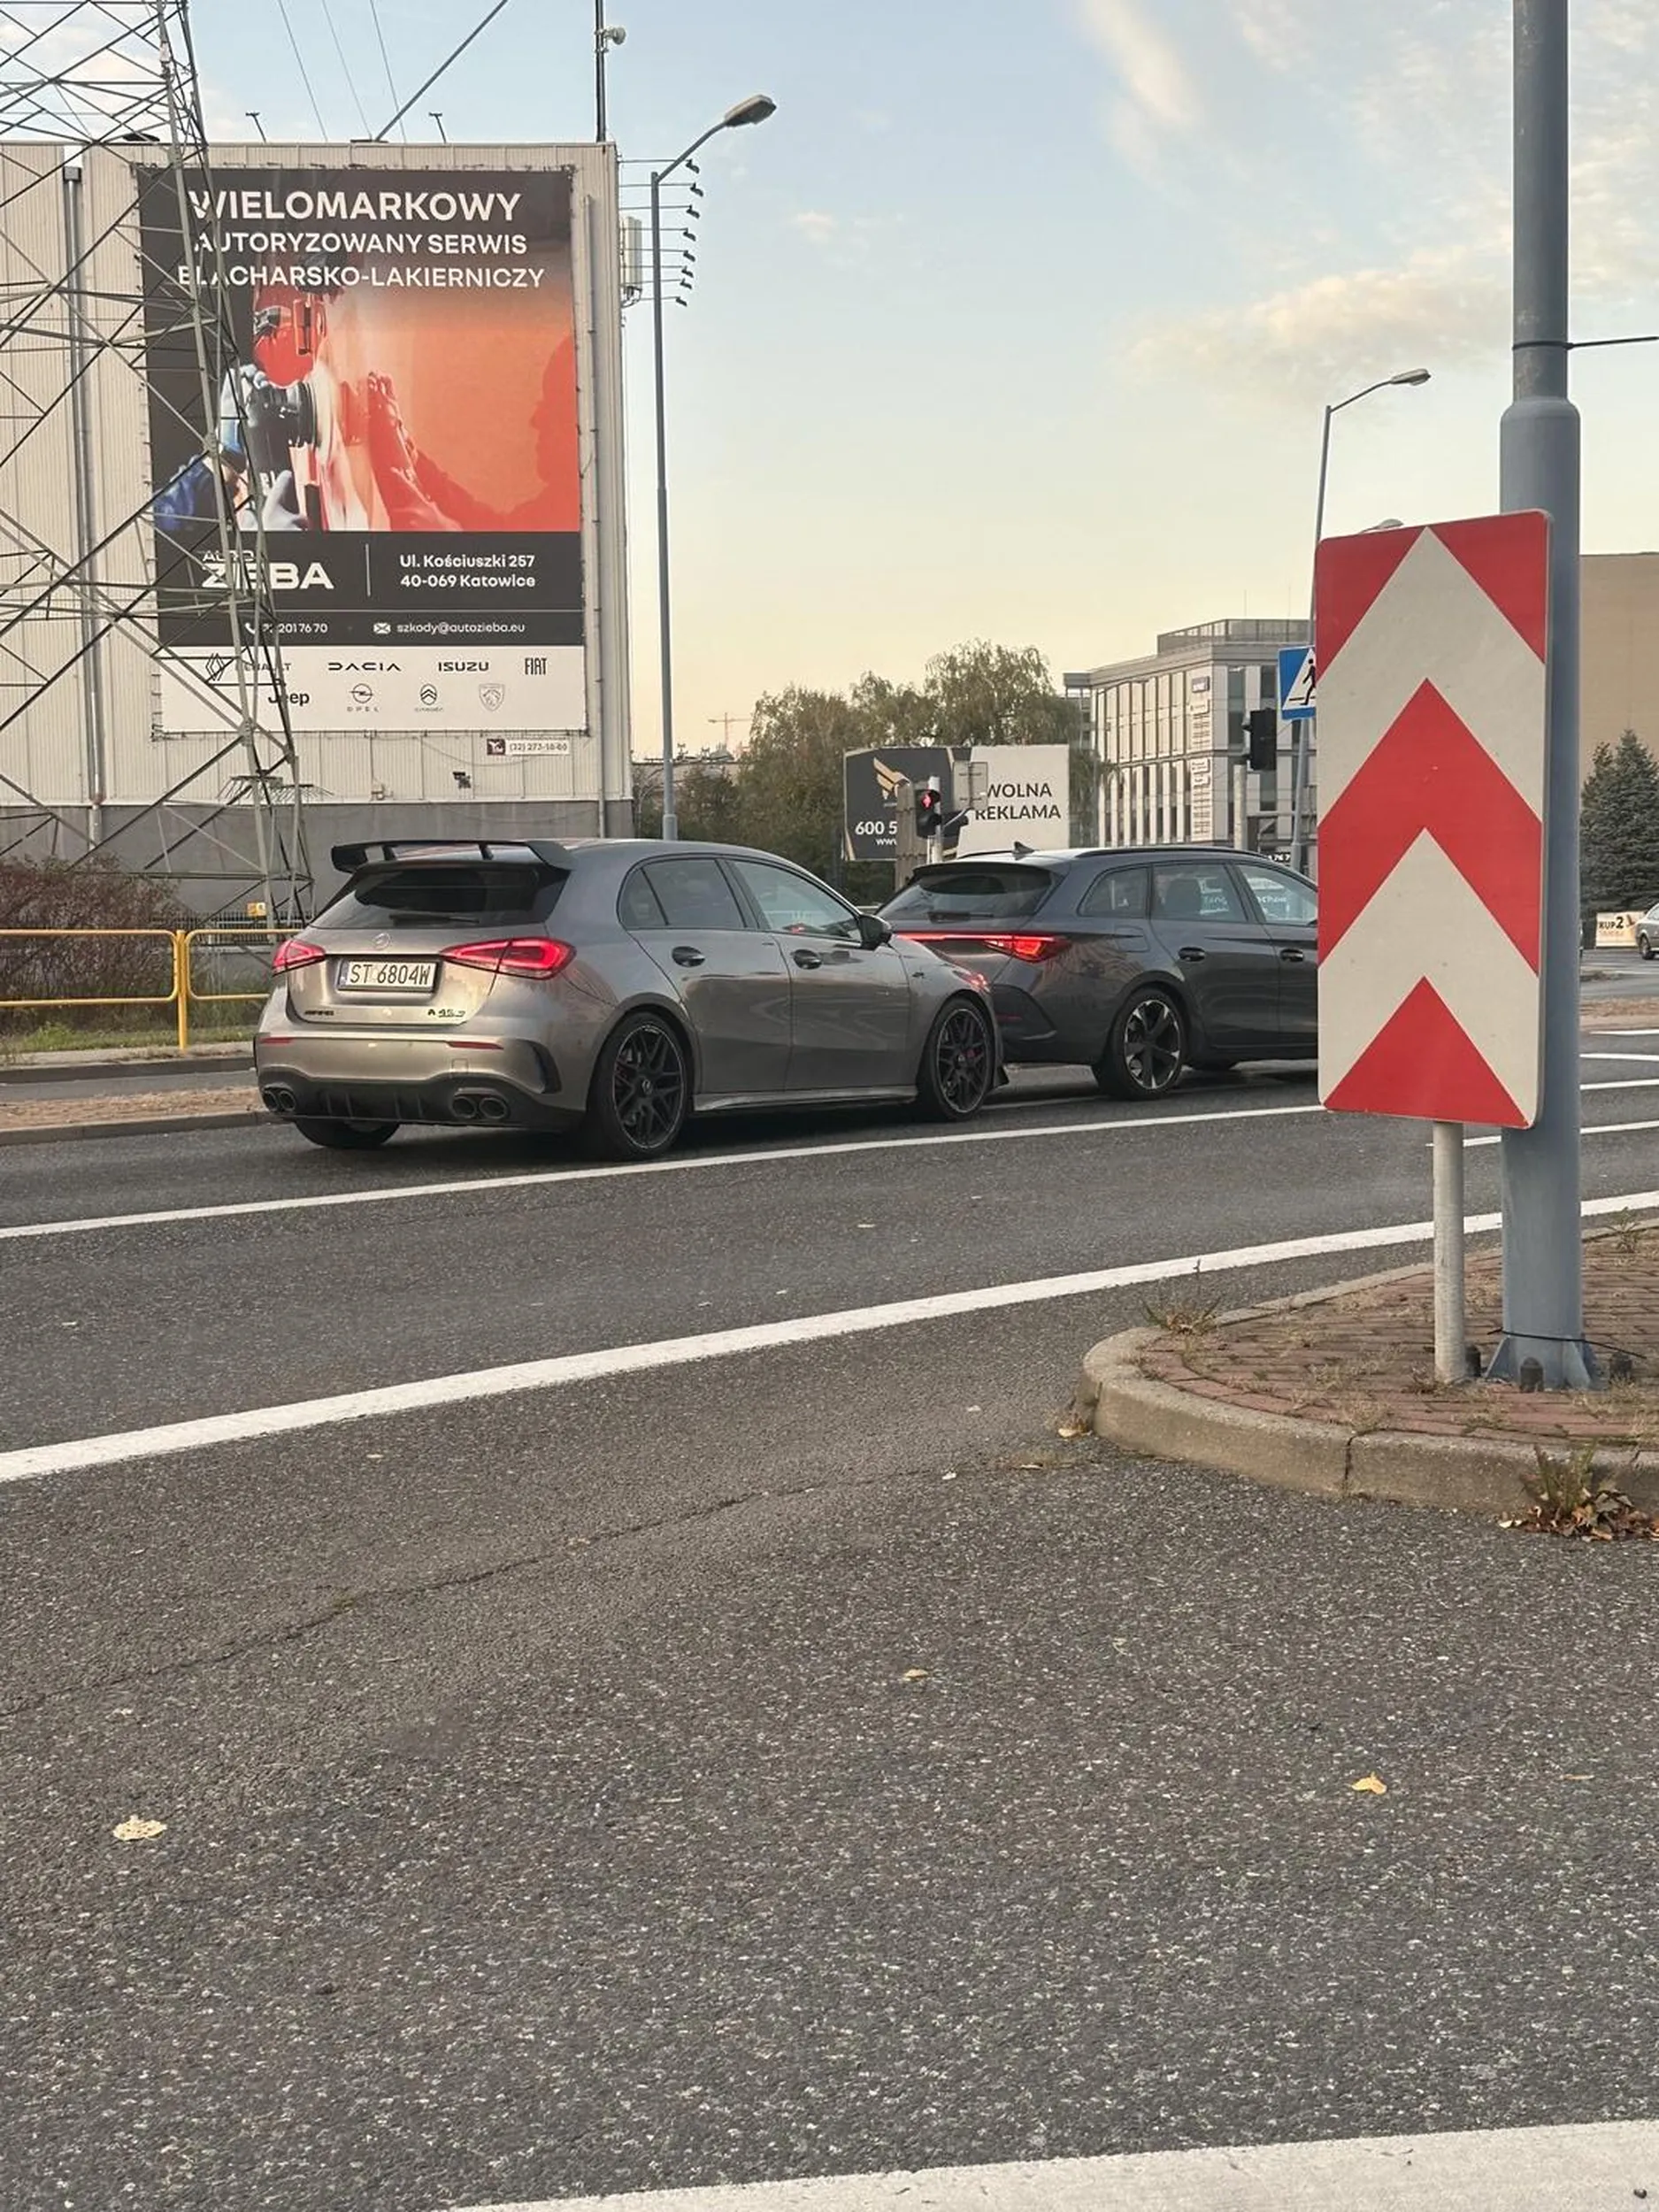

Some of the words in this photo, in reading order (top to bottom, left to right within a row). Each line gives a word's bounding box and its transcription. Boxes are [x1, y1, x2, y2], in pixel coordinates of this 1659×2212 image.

[188, 190, 521, 221] WIELOMARKOWY
[194, 232, 423, 254] AUTORYZOWANY
[427, 234, 528, 255] SERWIS
[178, 265, 544, 288] BLACHARSKO-LAKIERNICZY
[399, 553, 420, 568] Ul.
[423, 553, 506, 568] Kościuszki
[508, 554, 535, 568] 257
[400, 574, 457, 588] 40-069
[459, 574, 536, 588] Katowice
[396, 622, 526, 635] szkody@autozieba.eu
[327, 662, 402, 672] DACIA
[438, 661, 490, 672] ISUZU
[524, 657, 548, 675] FIAT
[987, 782, 1053, 798] WOLNA
[974, 803, 1062, 821] REKLAMA
[855, 820, 885, 835] 600
[349, 964, 373, 984] ST
[377, 964, 431, 986] 6804W
